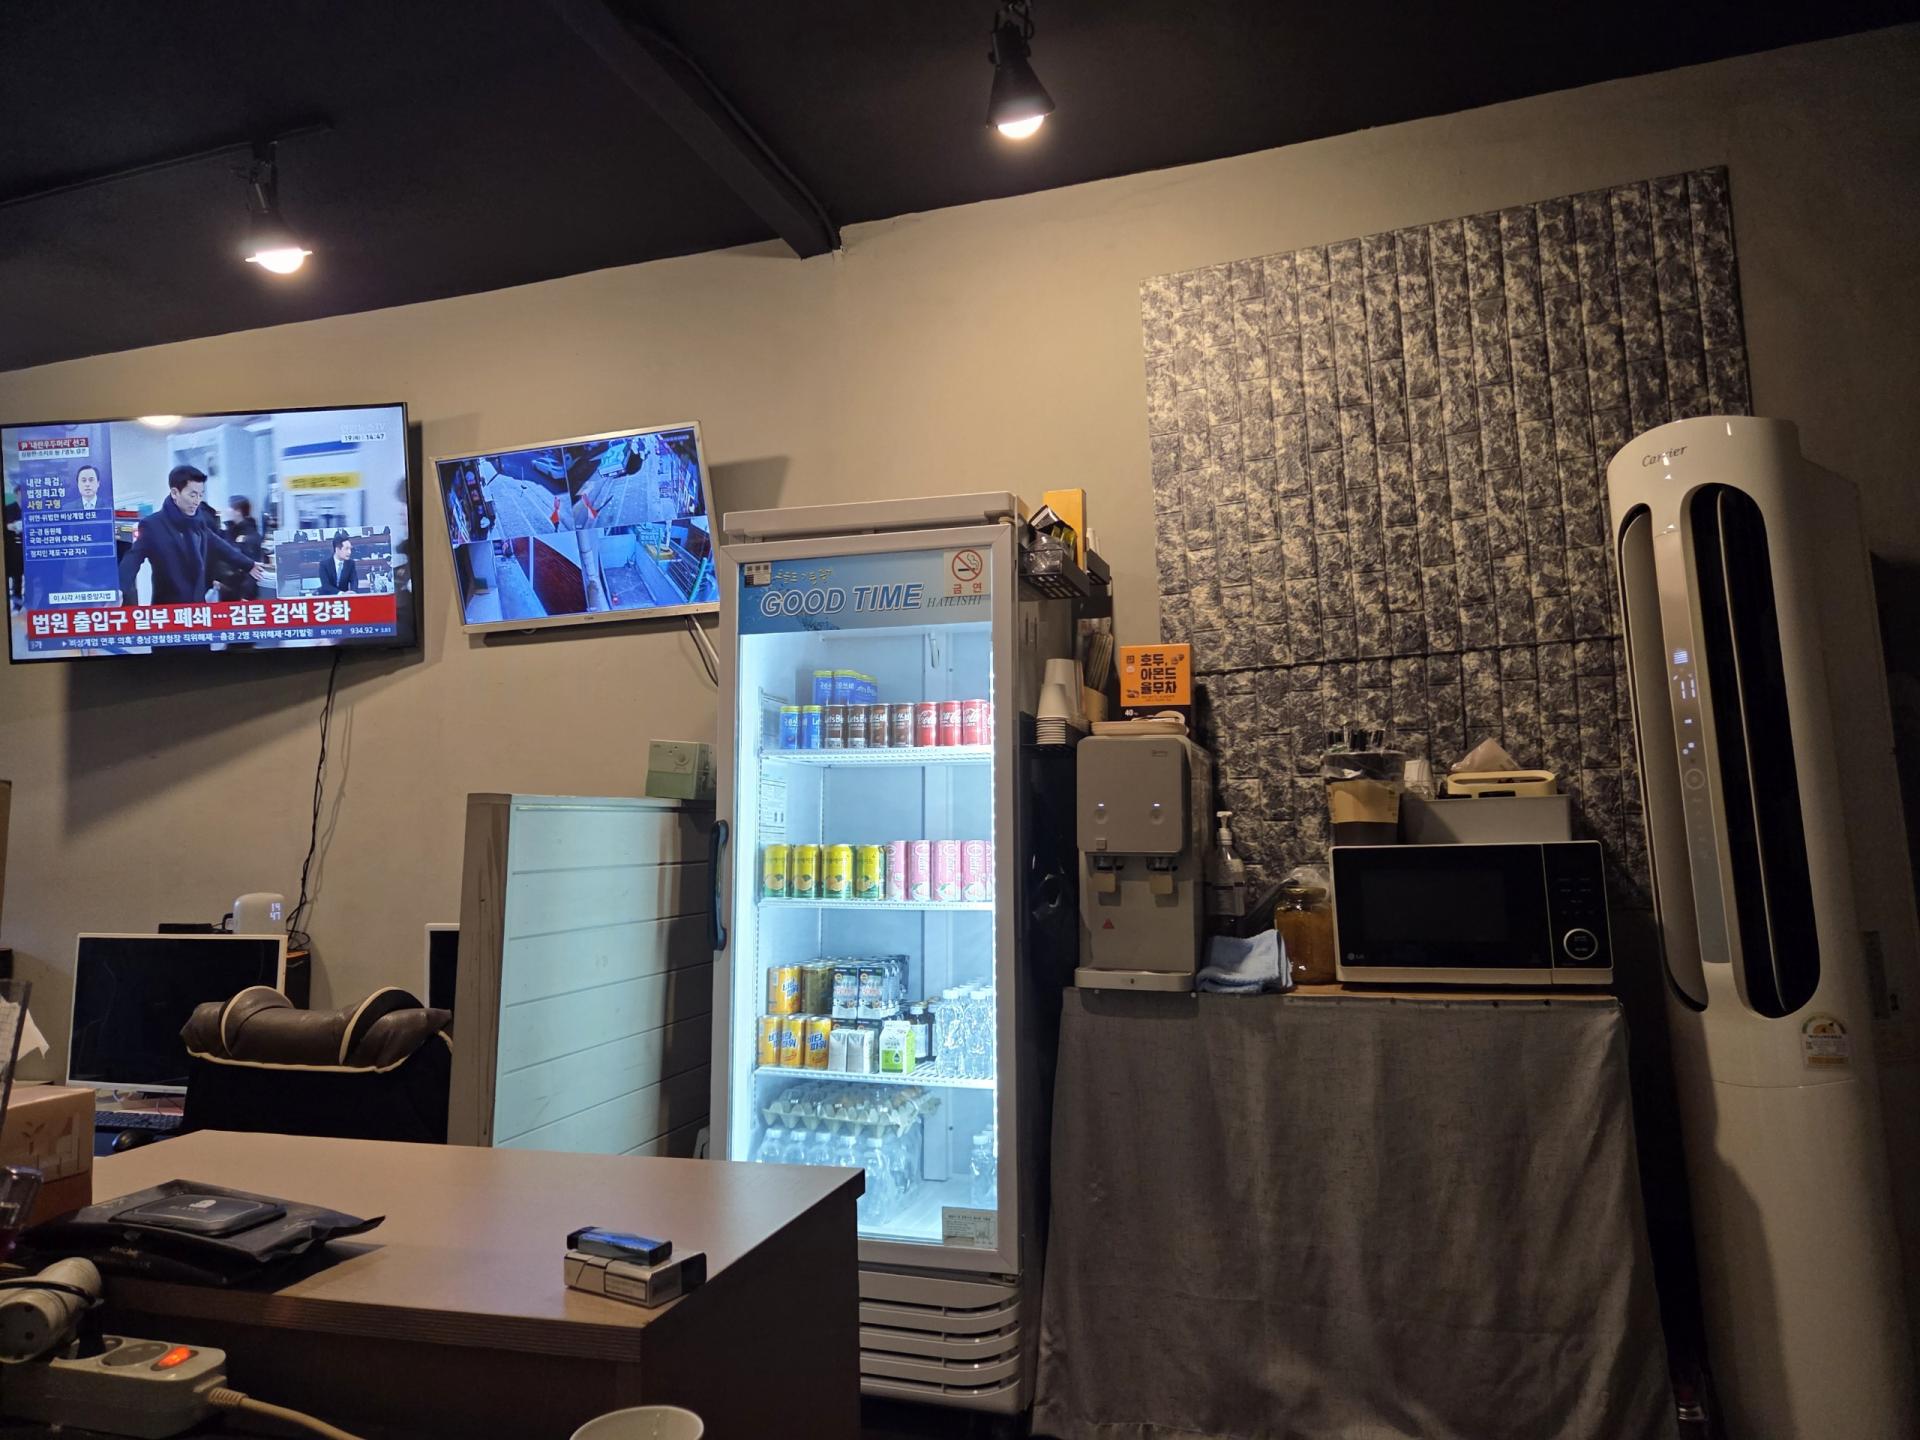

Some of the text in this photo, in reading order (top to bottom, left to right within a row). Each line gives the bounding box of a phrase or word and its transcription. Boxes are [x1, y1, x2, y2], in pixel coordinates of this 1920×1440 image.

[72, 438, 86, 447] 선고
[26, 477, 63, 488] 내란 특검,
[27, 488, 66, 499] 법정최고형
[27, 499, 61, 510] 사형 구형
[60, 512, 84, 520] 비상계엄
[85, 511, 97, 519] 선포
[80, 534, 93, 542] 시도
[952, 582, 982, 595] 금 연
[75, 592, 111, 601] 서울중앙지법
[760, 582, 925, 618] GOOD TIME
[32, 612, 69, 635] 법원
[73, 610, 129, 633] 출입구
[132, 608, 170, 630] 일부
[271, 602, 309, 624] 검색
[313, 600, 352, 622] 강화
[349, 626, 373, 635] 934.92
[100, 637, 115, 647] 연루
[136, 634, 181, 645] 충남경찰청장
[237, 631, 250, 640] 2명
[1141, 653, 1168, 667] 호두,
[1141, 667, 1177, 681] 아몬드
[1141, 681, 1177, 695] 율무차
[810, 1031, 823, 1042] 비타
[811, 1040, 827, 1051] 파워
